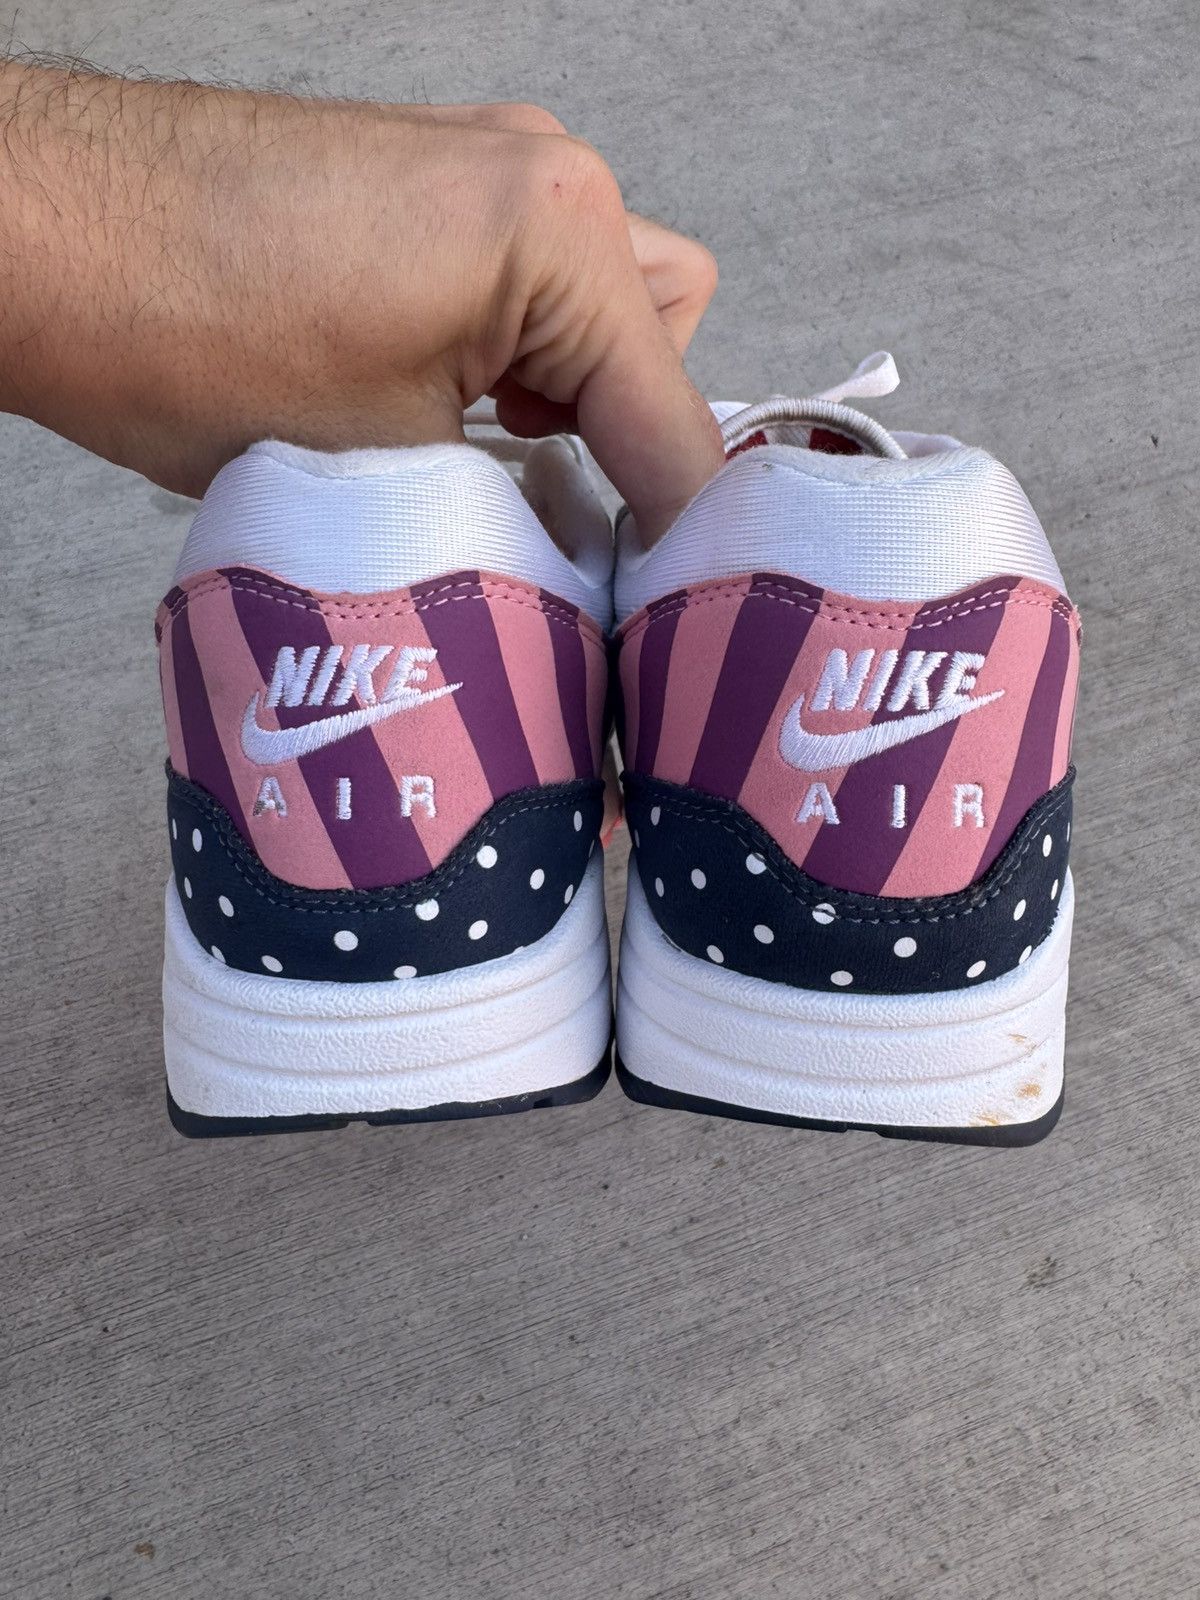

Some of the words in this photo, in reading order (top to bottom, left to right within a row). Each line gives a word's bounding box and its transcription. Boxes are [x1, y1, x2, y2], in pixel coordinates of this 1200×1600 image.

[264, 643, 438, 708] NIKE
[809, 647, 986, 712] NIKE
[252, 774, 437, 820] AIR
[794, 781, 986, 829] AIR
